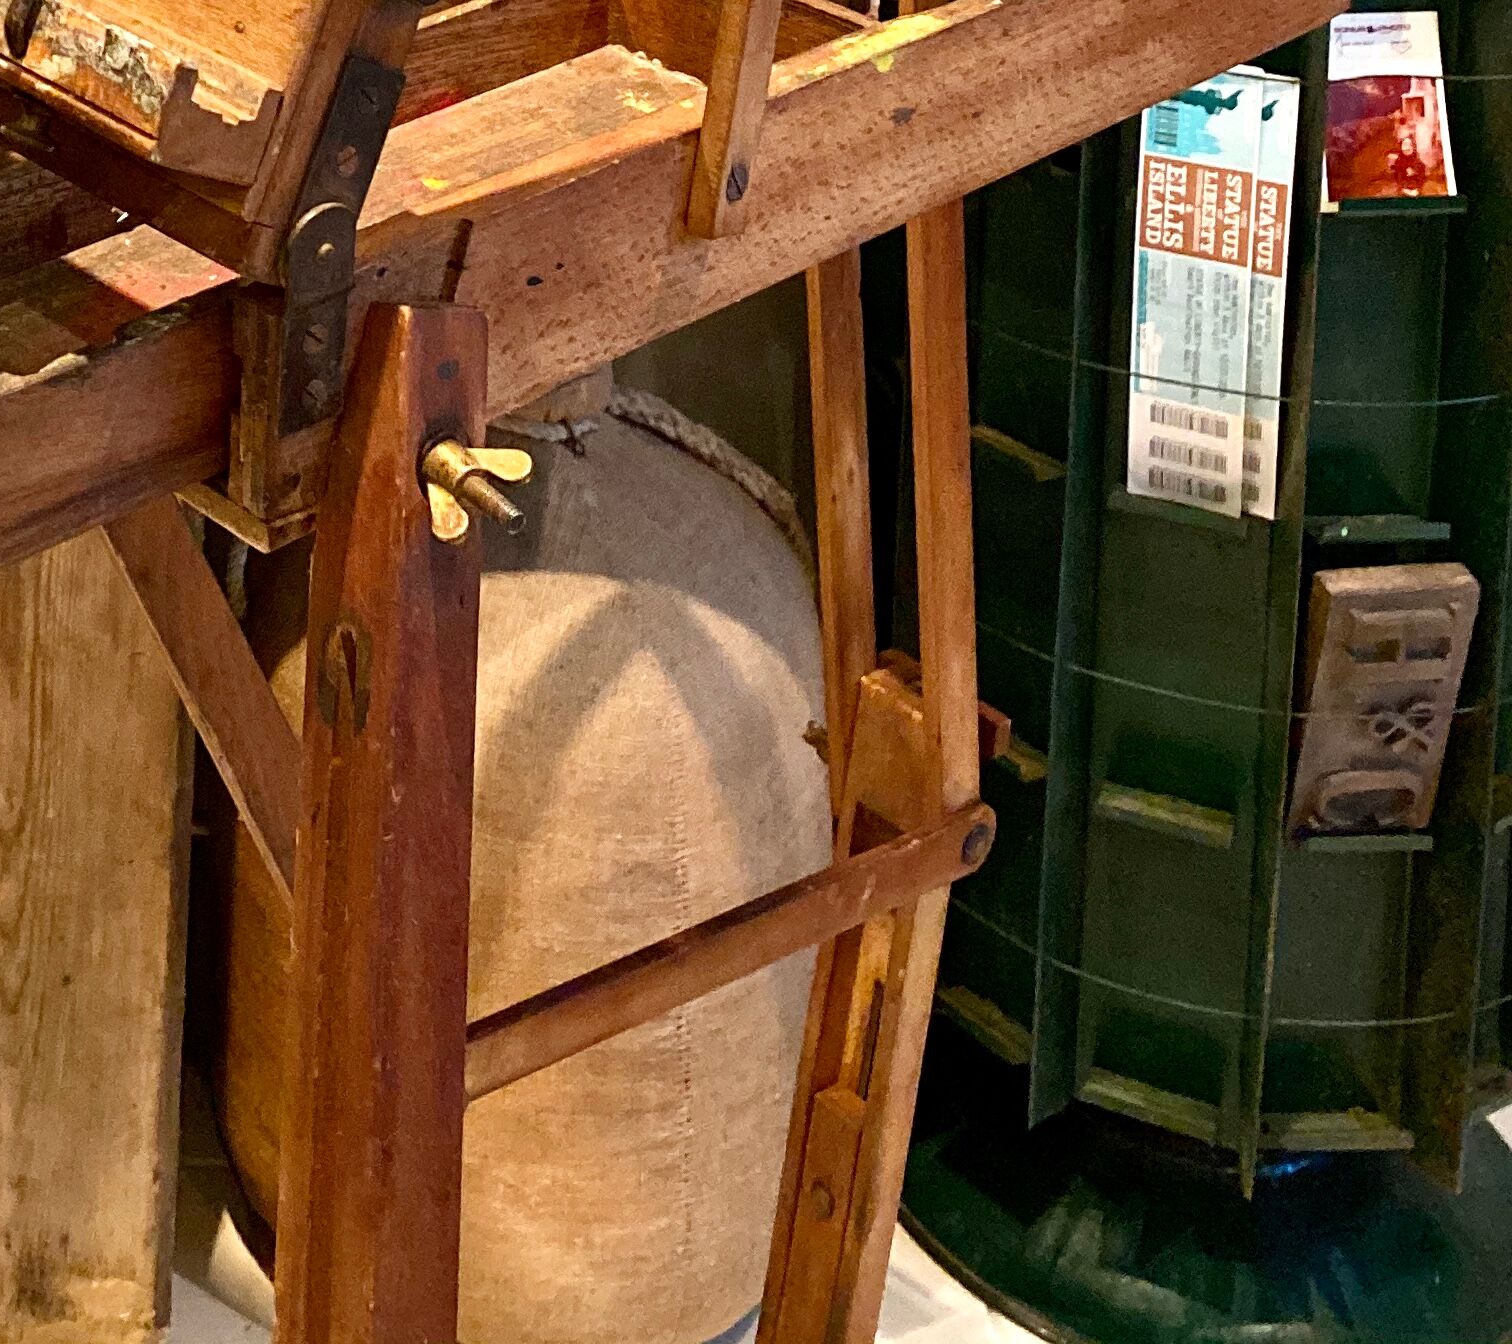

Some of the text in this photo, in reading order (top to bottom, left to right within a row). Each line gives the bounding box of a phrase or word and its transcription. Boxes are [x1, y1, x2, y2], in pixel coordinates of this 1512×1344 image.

[1145, 160, 1166, 244] ISLAND
[1162, 163, 1187, 249] ELLIS
[1200, 170, 1219, 255] LIBERTY
[1222, 173, 1243, 260] STATUE
[1256, 185, 1278, 271] STATUE
